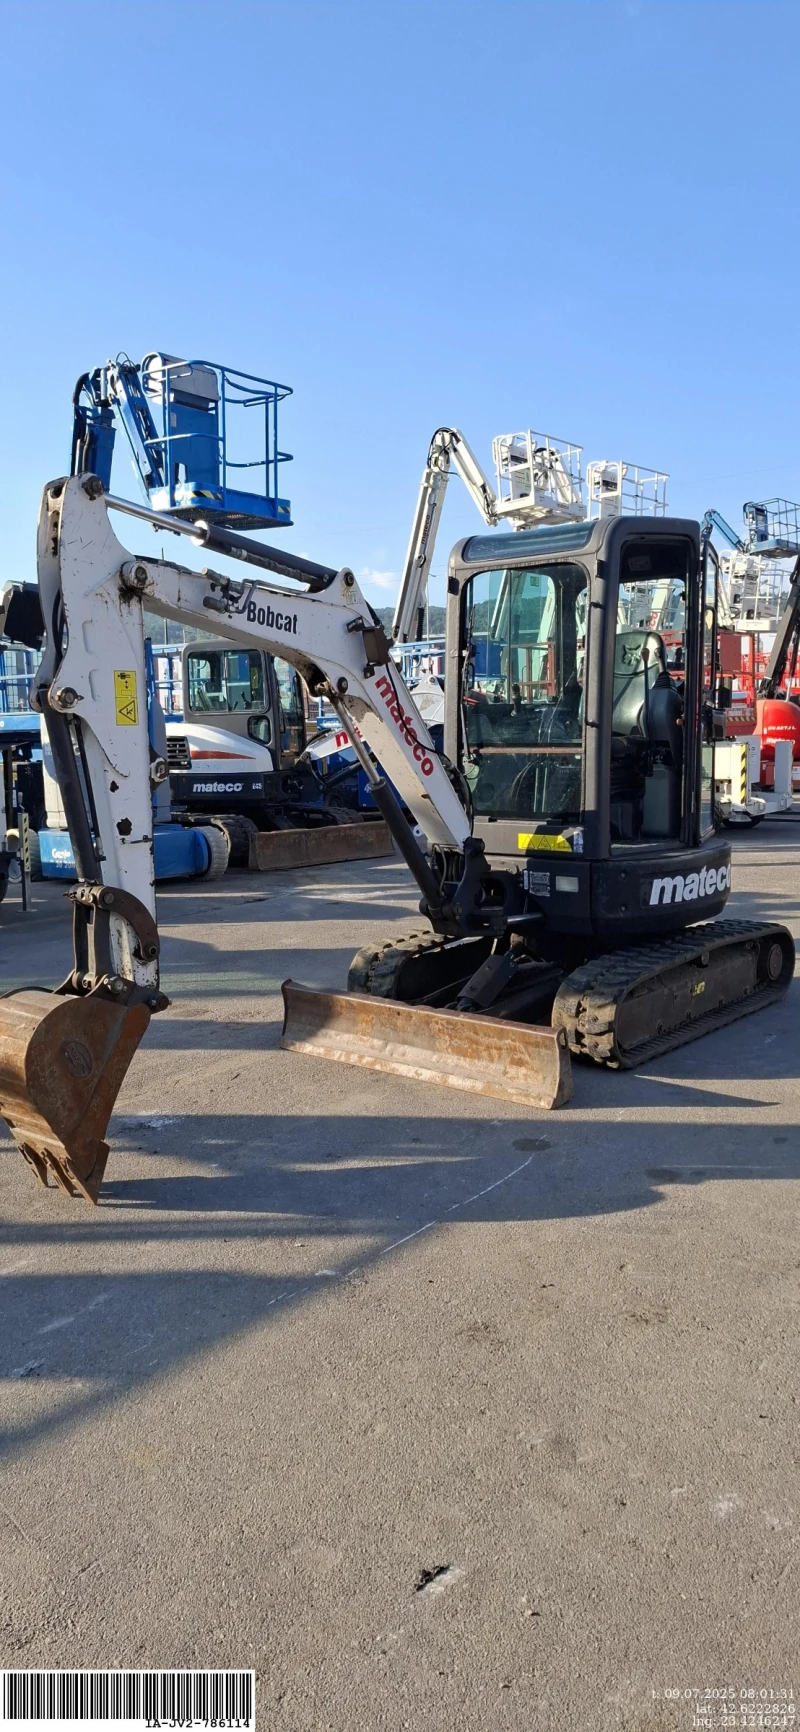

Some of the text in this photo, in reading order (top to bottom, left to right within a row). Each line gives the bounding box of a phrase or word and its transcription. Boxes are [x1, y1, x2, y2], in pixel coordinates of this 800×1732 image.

[247, 601, 297, 635] Bobcat
[375, 675, 434, 776] mateco
[192, 781, 243, 793] mateco
